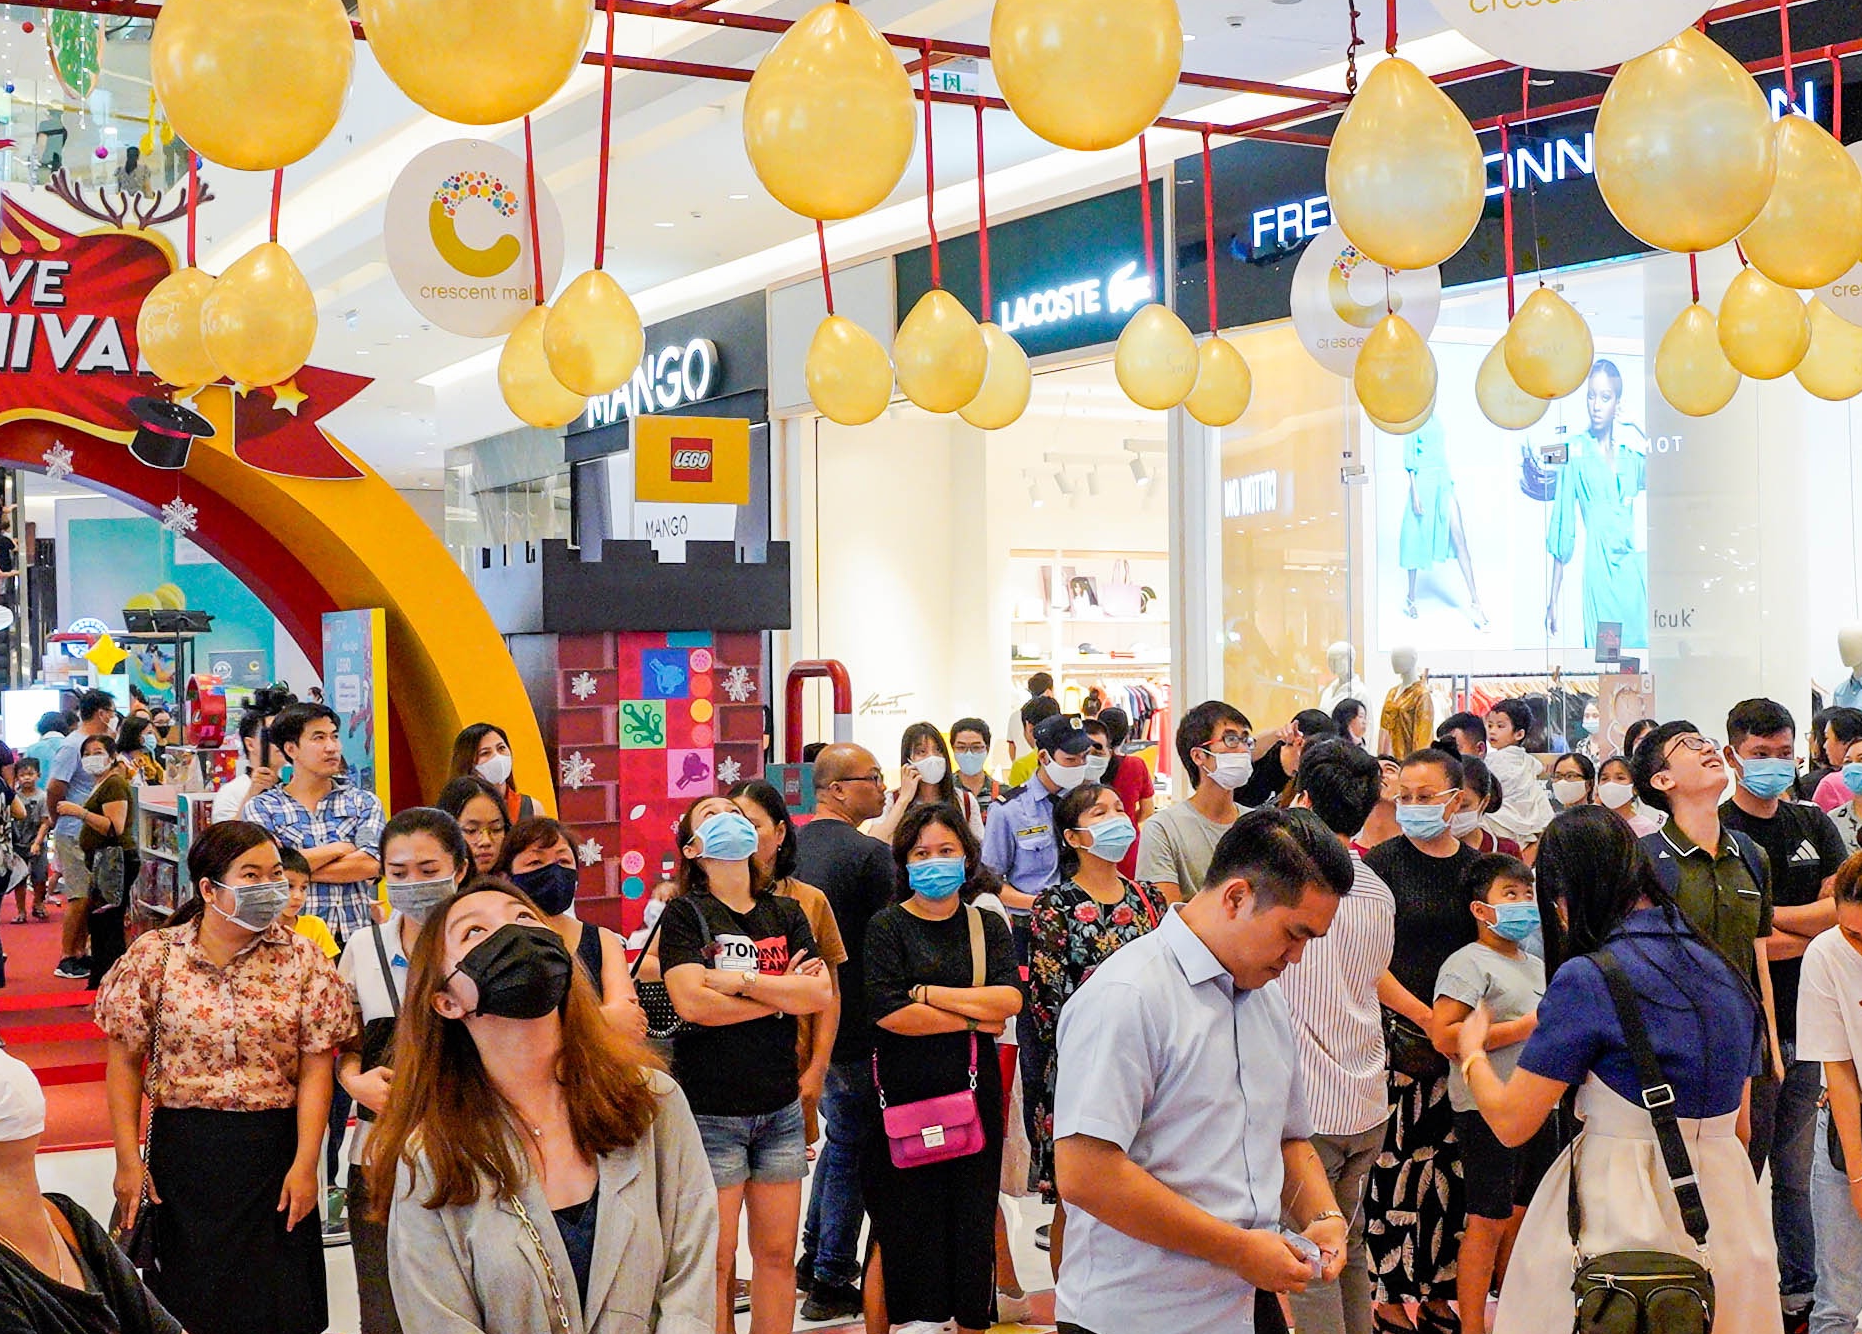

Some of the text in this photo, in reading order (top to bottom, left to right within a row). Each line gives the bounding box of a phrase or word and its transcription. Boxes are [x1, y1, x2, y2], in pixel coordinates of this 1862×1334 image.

[1253, 194, 1336, 249] FRE
[420, 284, 534, 300] crescent mal
[1001, 279, 1100, 332] LACOSTE
[1316, 336, 1364, 349] cresce
[587, 339, 711, 429] MANGO
[673, 450, 710, 470] LEGO
[645, 515, 688, 538] MANGO
[724, 942, 788, 961] TOMMY
[752, 959, 789, 972] JEAN
